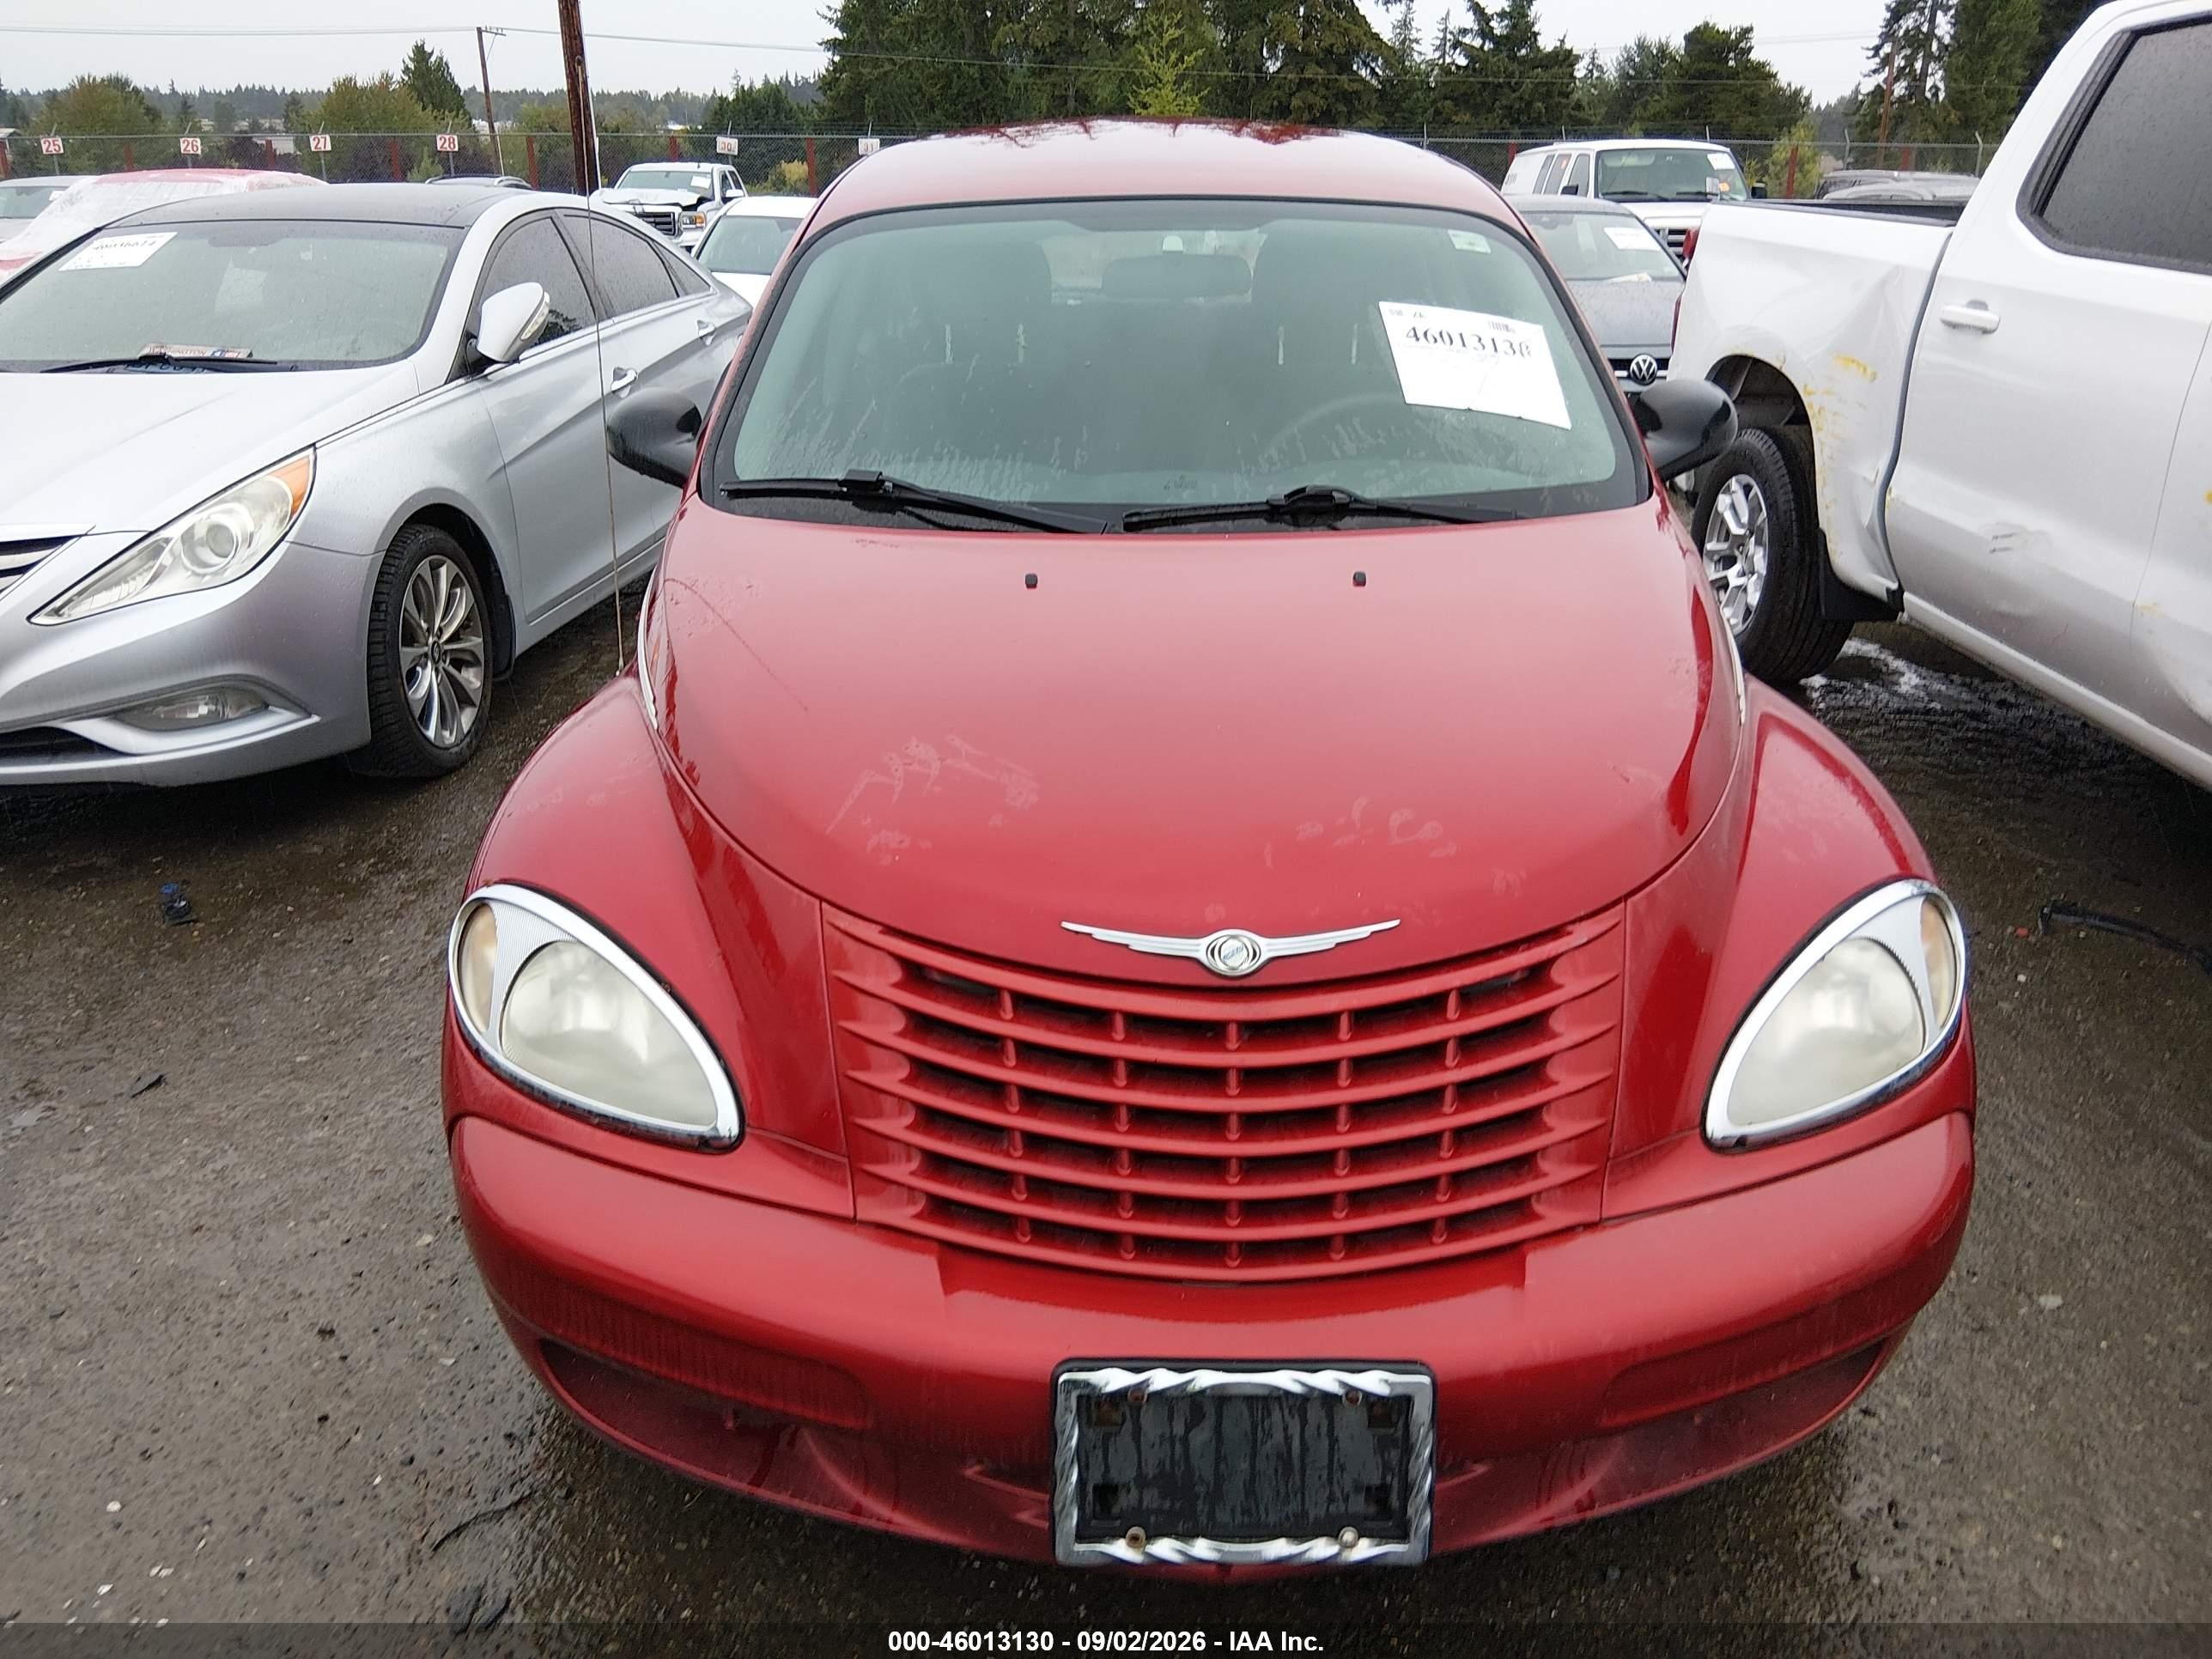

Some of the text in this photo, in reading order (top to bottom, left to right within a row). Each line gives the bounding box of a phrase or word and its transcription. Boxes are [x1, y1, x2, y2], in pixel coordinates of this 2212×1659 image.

[43, 139, 62, 153] 25
[182, 139, 199, 152] 26
[313, 137, 328, 150] 27
[439, 137, 456, 150] 28
